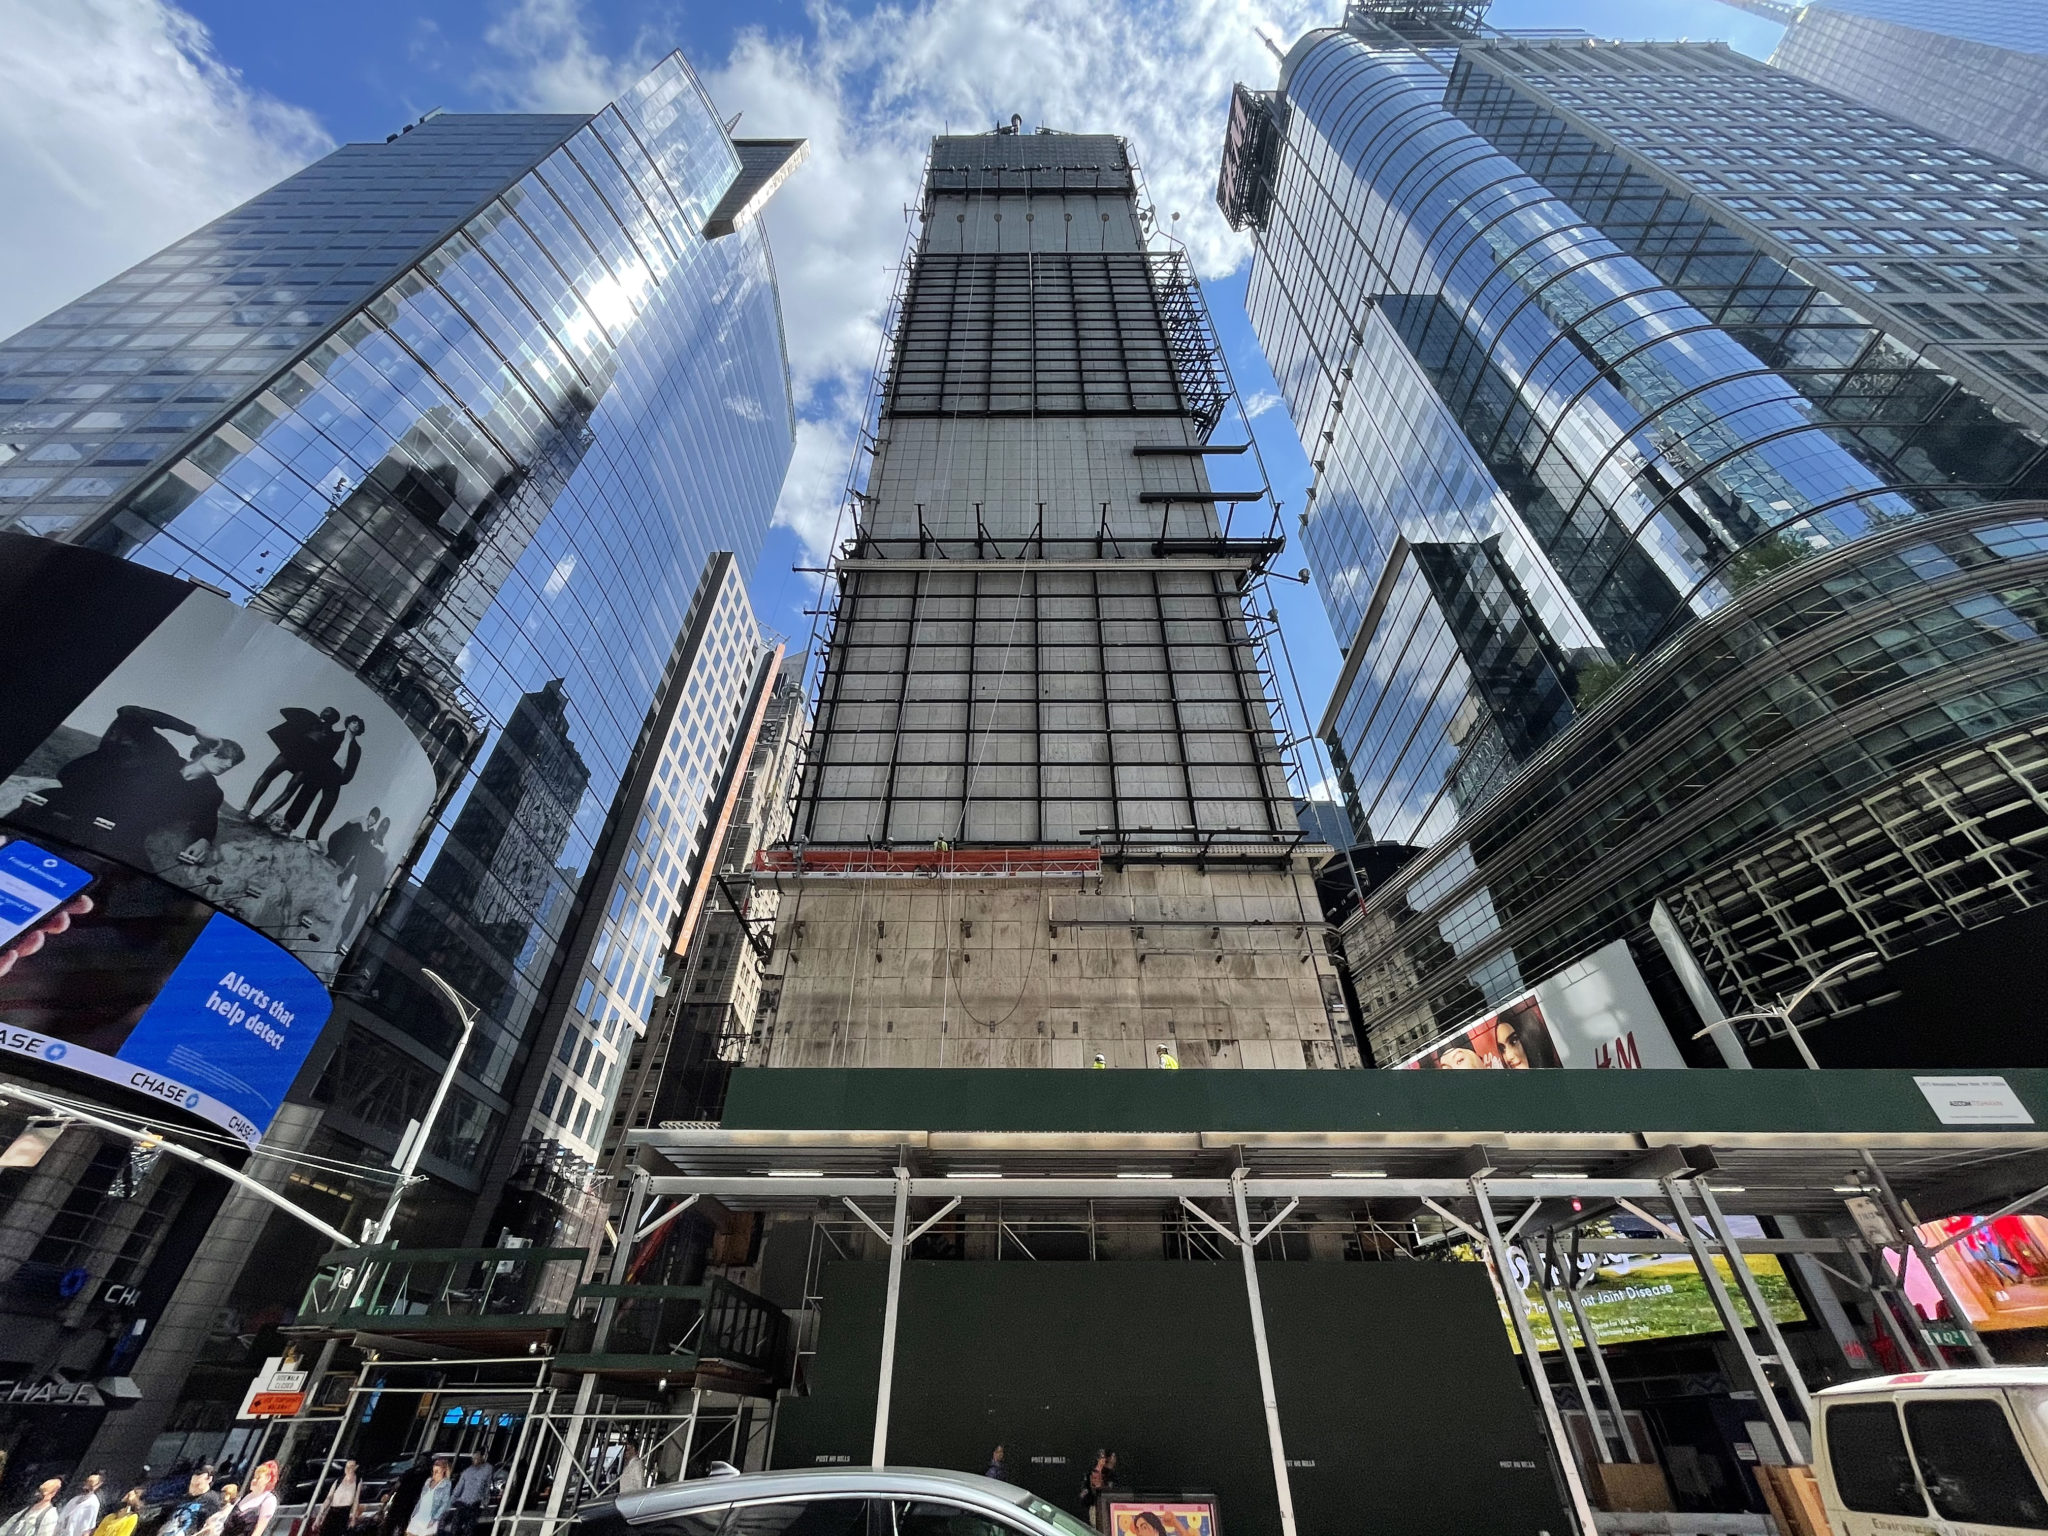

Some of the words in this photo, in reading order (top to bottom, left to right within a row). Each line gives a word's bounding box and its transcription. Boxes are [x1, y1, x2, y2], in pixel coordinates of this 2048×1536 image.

[218, 971, 270, 1009] Alerts
[268, 1000, 295, 1028] that
[205, 990, 246, 1026] help
[244, 1013, 285, 1050] detect
[1594, 1031, 1642, 1069] HM
[130, 1072, 187, 1103] CHASE
[1556, 1294, 1596, 1313] Agnst
[1597, 1290, 1625, 1306] Joint
[1625, 1283, 1674, 1301] Disease
